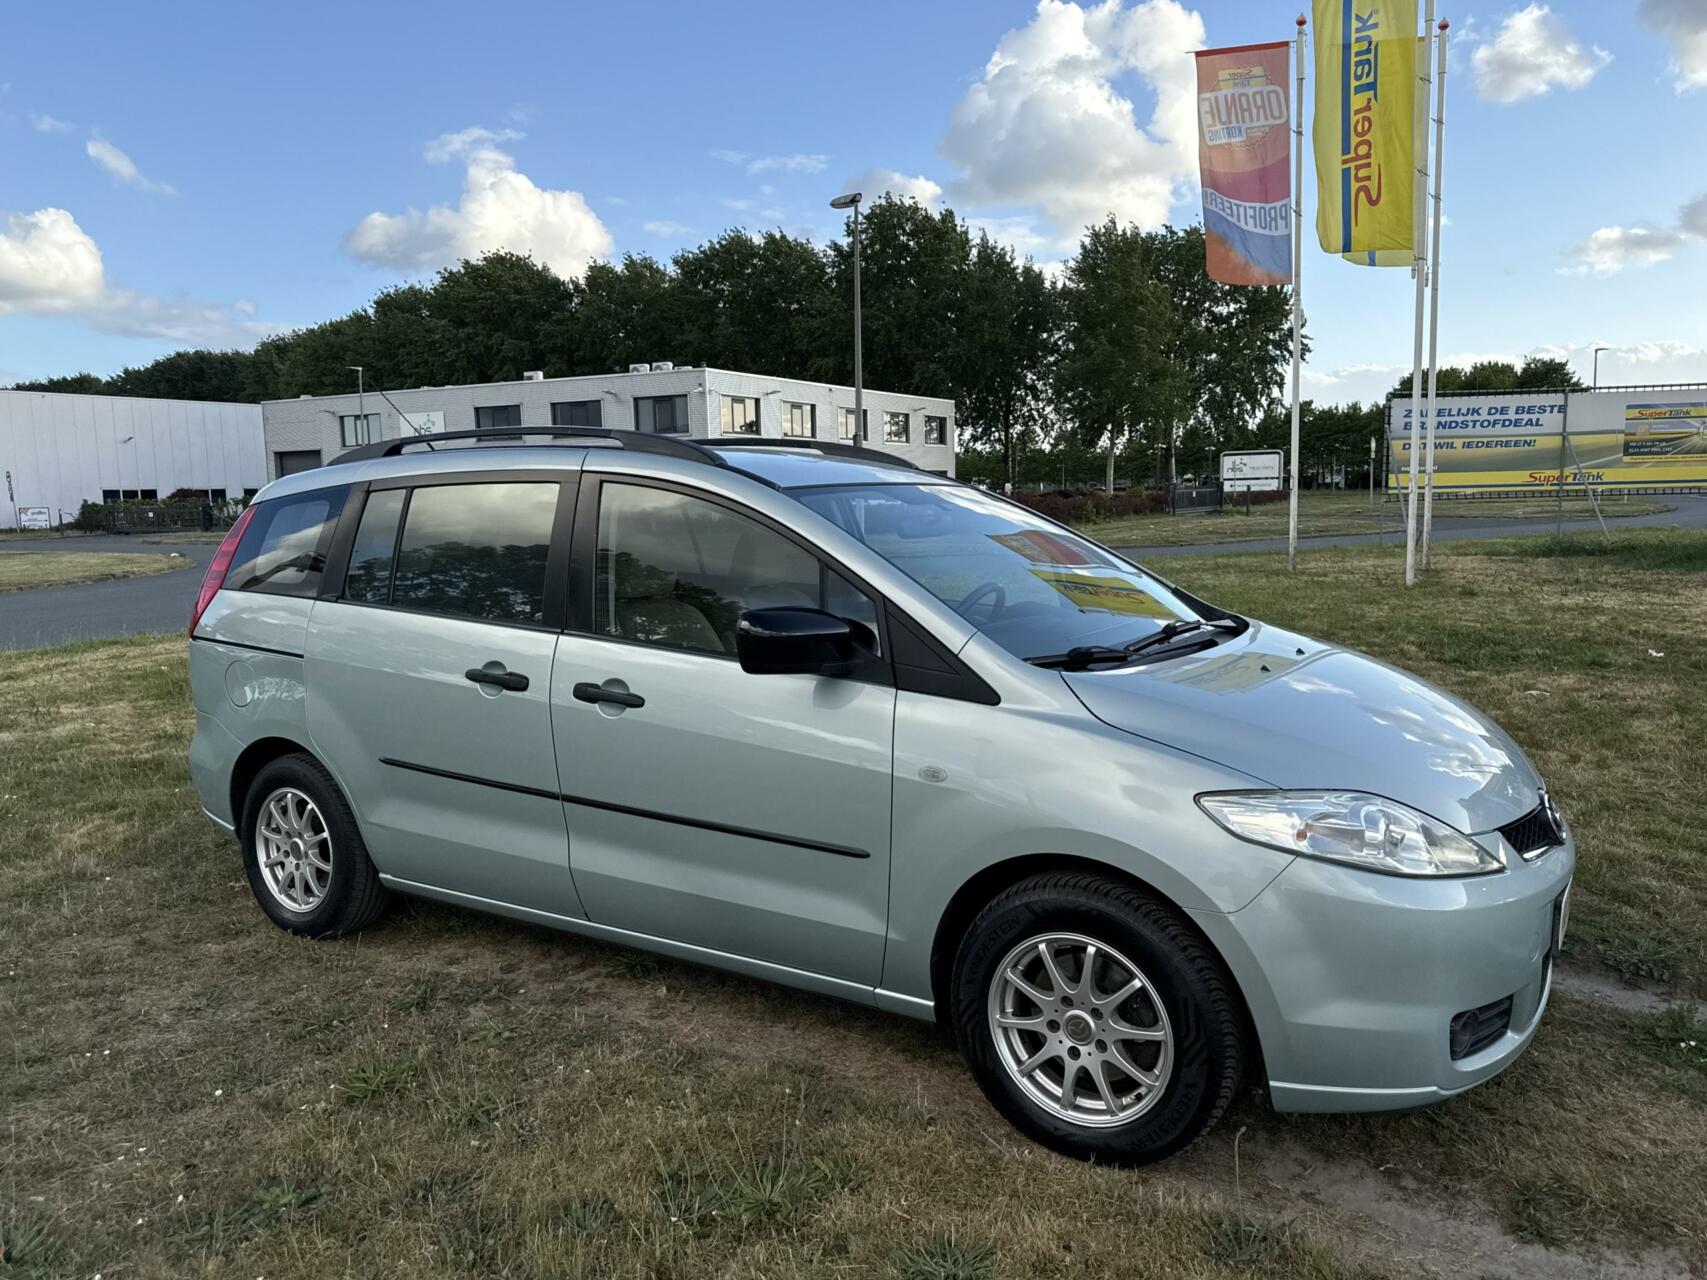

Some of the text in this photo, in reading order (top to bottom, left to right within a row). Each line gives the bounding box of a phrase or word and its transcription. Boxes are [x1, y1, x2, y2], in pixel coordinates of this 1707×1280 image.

[1487, 406, 1511, 416] DE
[1403, 418, 1544, 430] BRNDSTOFDEAL
[1434, 441, 1457, 450] WIL
[1461, 439, 1537, 449] IEDEREEN!
